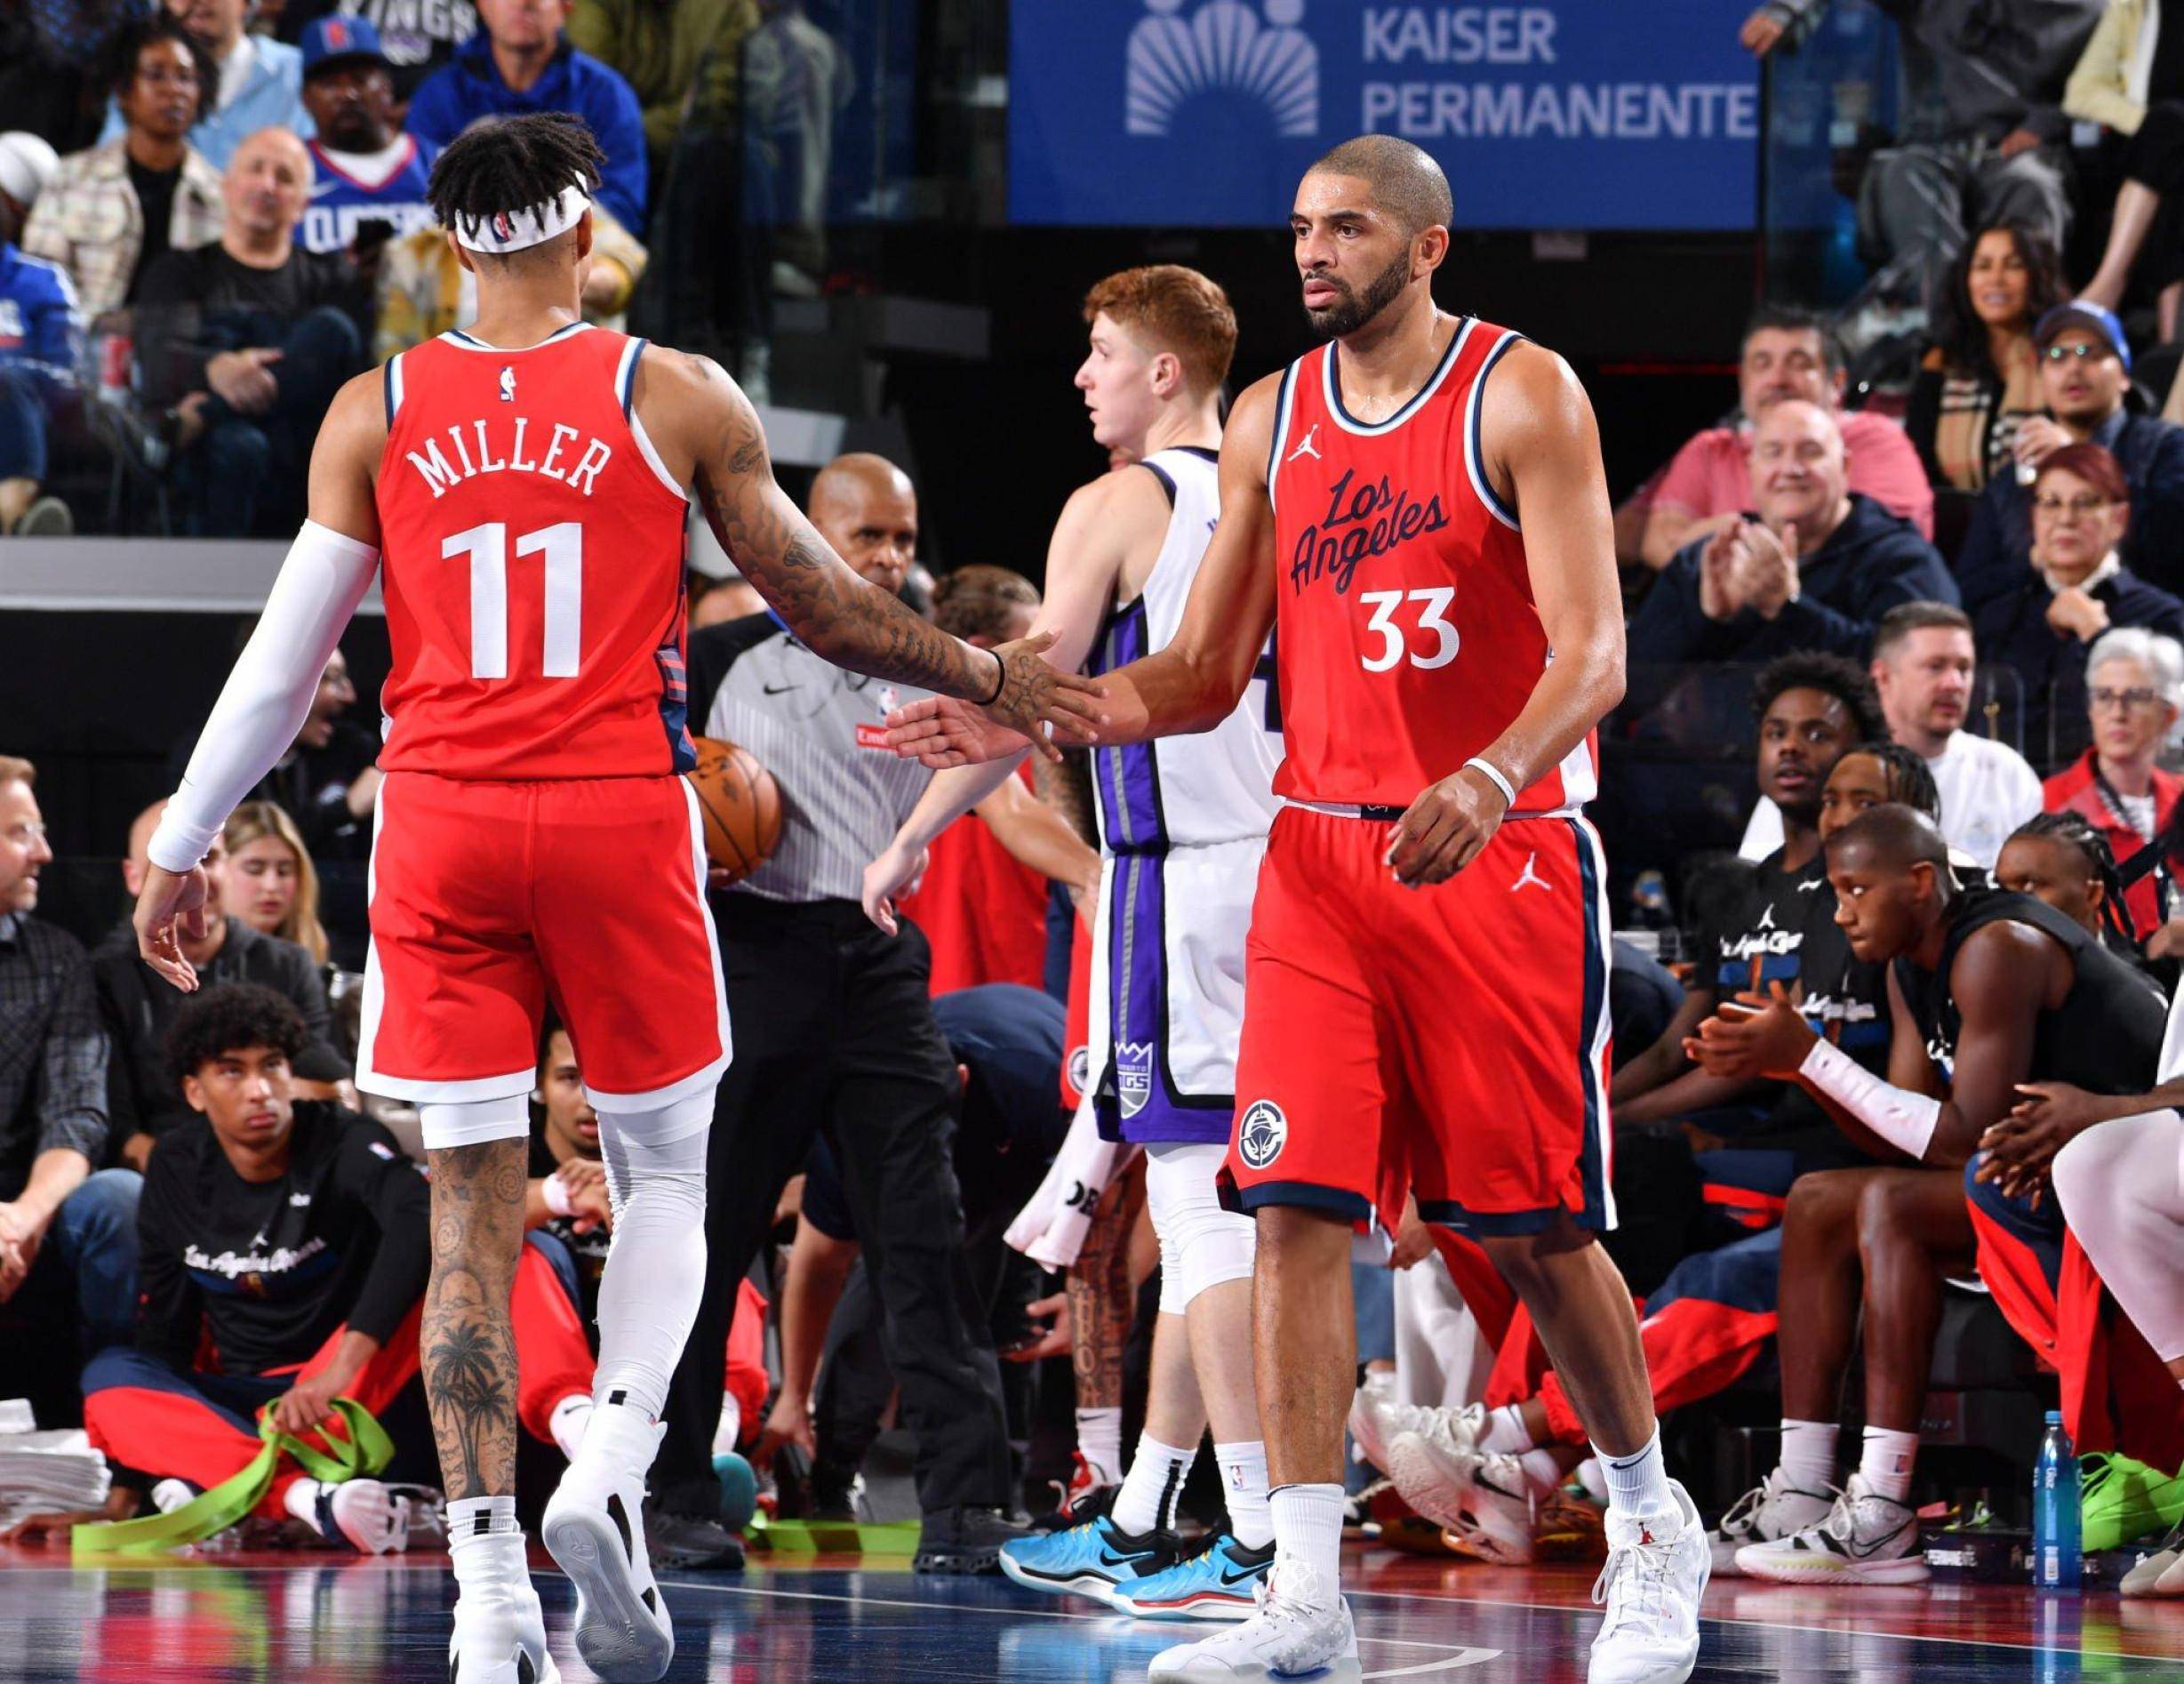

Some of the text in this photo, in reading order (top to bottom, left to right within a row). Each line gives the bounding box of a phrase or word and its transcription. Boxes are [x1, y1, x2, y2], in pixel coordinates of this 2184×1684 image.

[1363, 8, 1556, 63] KAISER
[1362, 84, 1756, 137] PERMANENTE
[405, 417, 612, 499] MILLER
[1321, 468, 1394, 530] Los
[1291, 490, 1451, 597] Angeles
[442, 522, 582, 679] 11
[1359, 586, 1460, 673] 33
